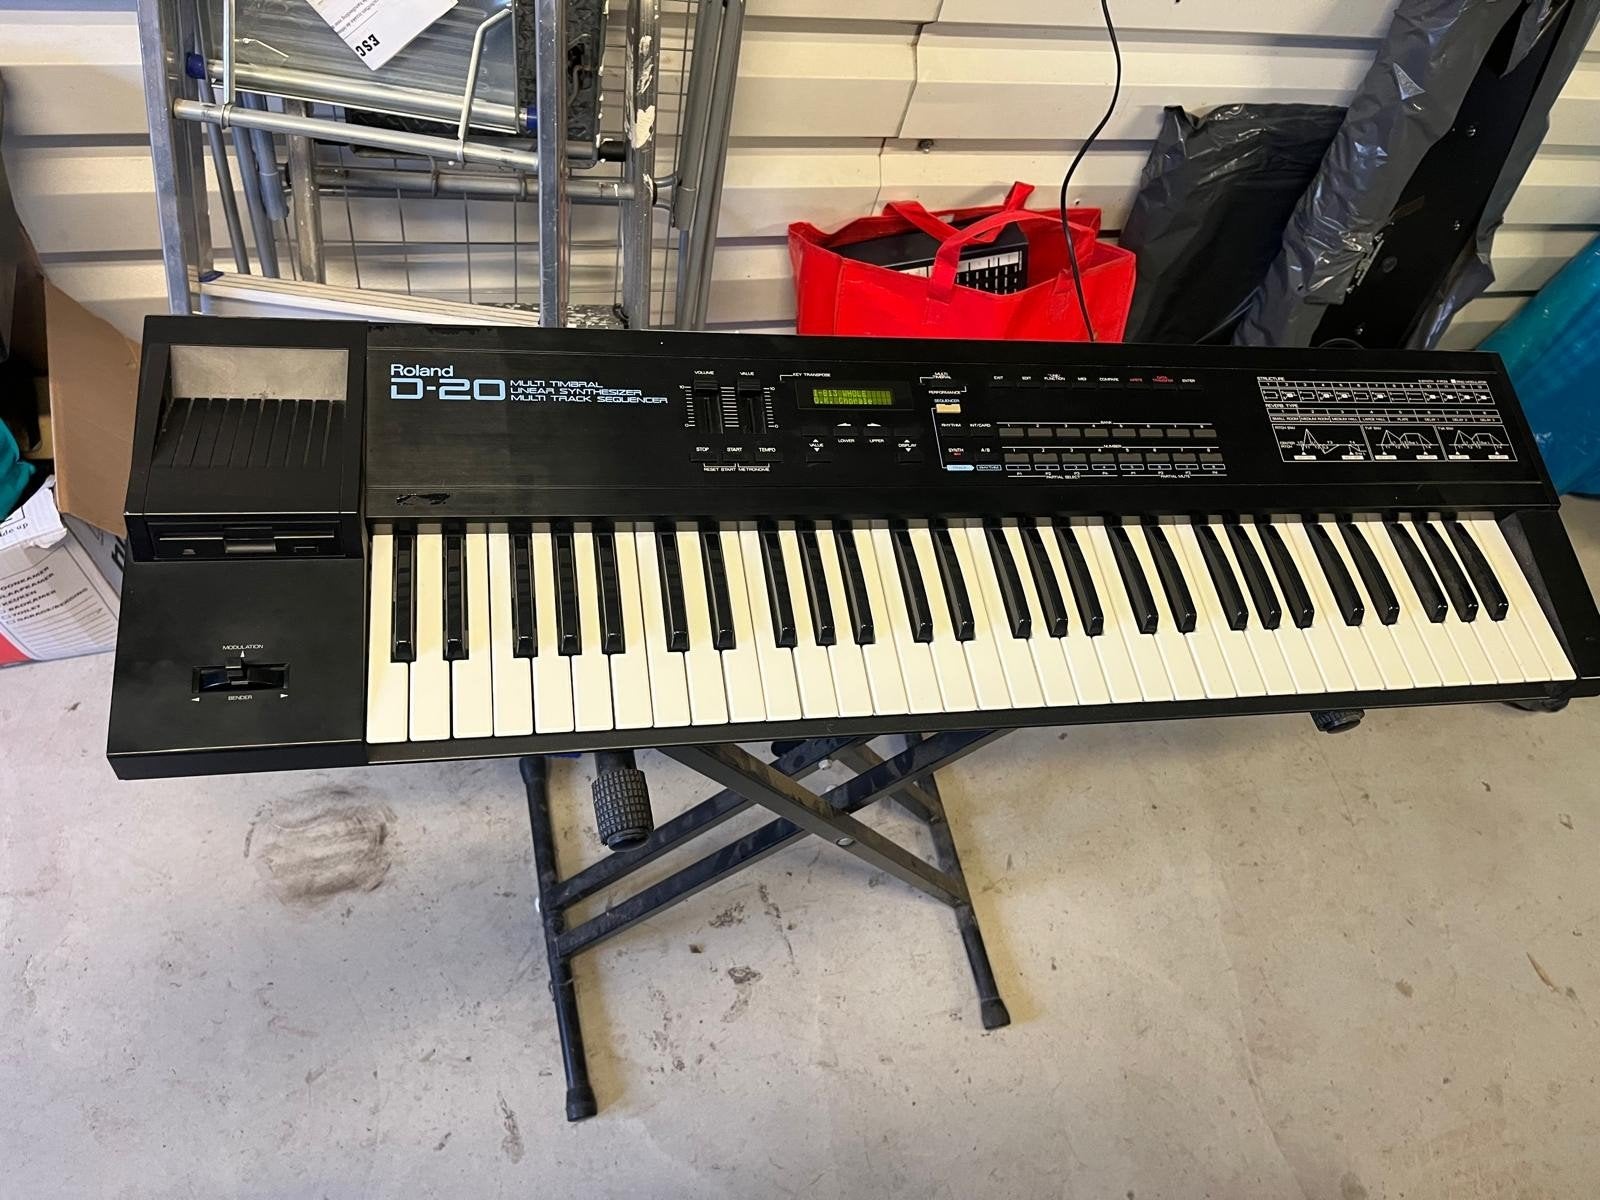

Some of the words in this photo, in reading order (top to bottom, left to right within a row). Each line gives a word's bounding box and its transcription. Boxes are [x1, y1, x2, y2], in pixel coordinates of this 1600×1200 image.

[390, 363, 454, 377] Roland
[390, 377, 506, 401] D-20
[510, 379, 546, 388] MULTI
[549, 380, 604, 389] TIMBRAL
[510, 387, 555, 395] LINEAR
[559, 387, 643, 397] SYNTHESIZER
[510, 394, 547, 402] MULTI
[549, 395, 592, 403] TRACK
[596, 396, 669, 405] SEQUENCER
[0, 566, 49, 591] OONKAMER
[222, 643, 264, 651] MODULATION
[227, 694, 253, 702] BENDER
